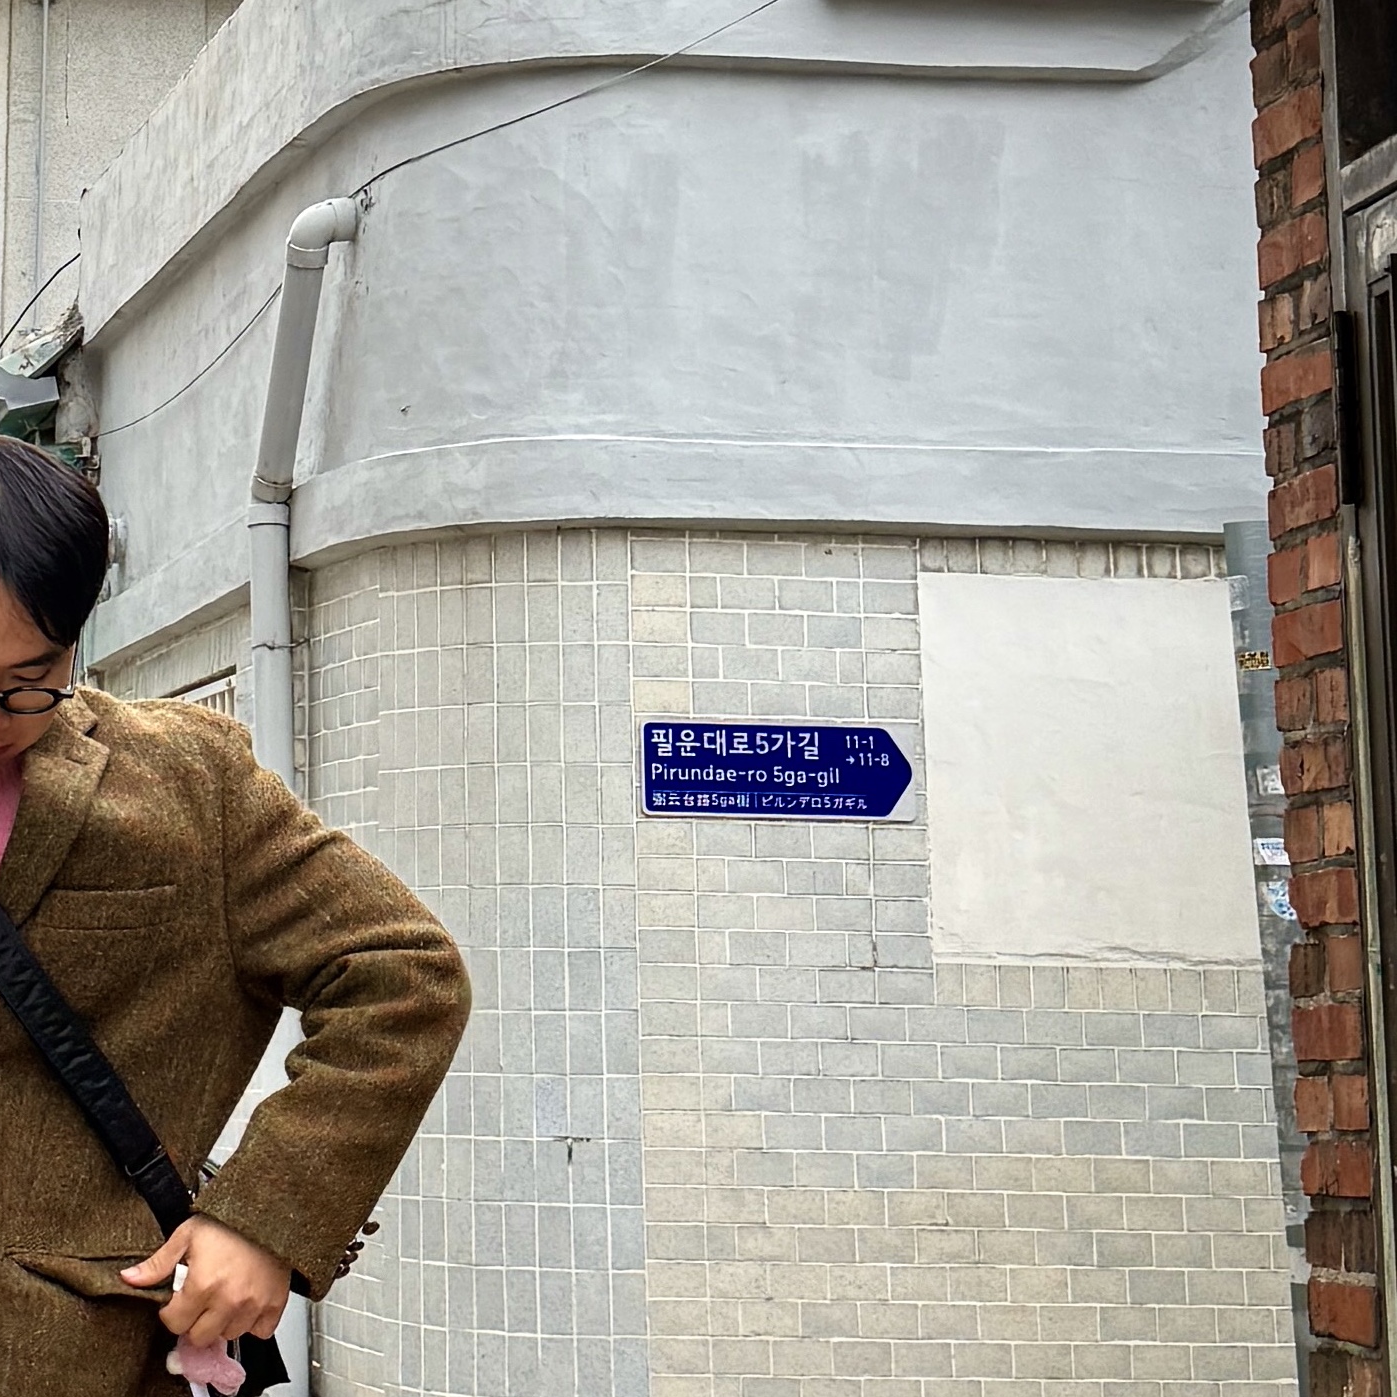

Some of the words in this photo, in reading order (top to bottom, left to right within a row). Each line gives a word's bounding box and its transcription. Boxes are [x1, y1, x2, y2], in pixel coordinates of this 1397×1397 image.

[651, 728, 820, 760] 필운대로5가길
[845, 735, 874, 750] 11-1
[858, 752, 890, 767] 11-8
[651, 763, 768, 783] Pirundae-ro
[773, 765, 840, 788] 5ga-gil
